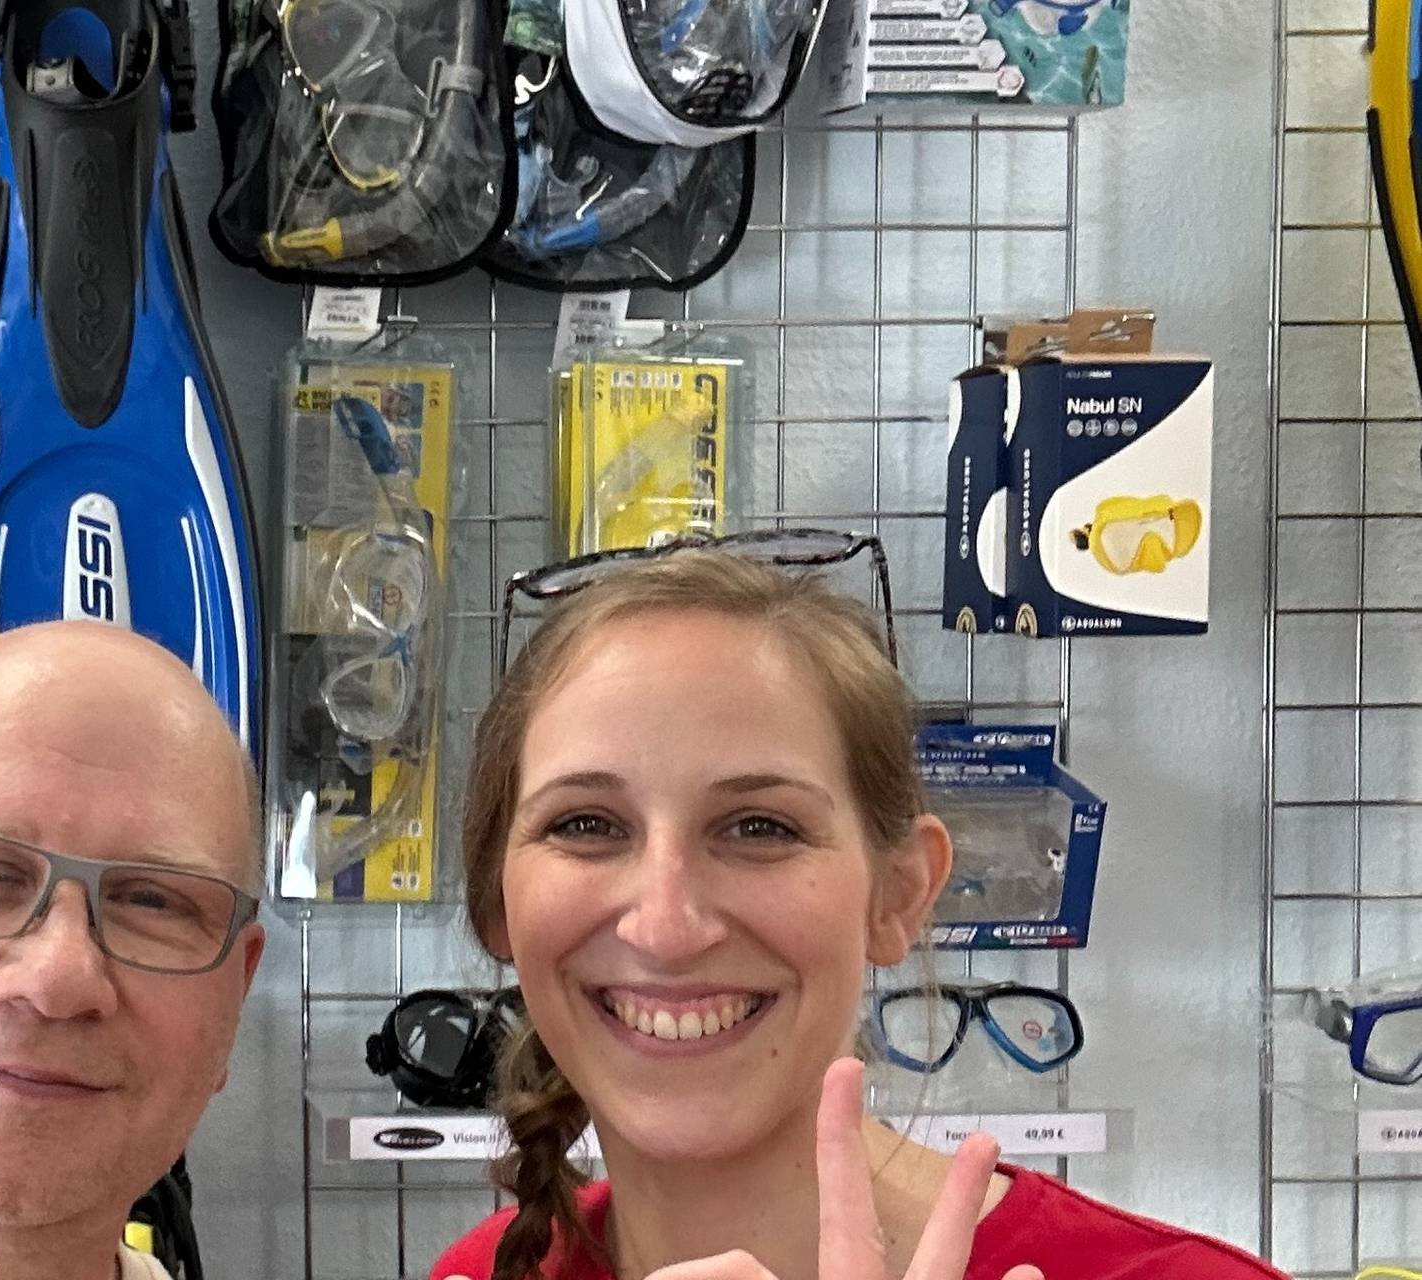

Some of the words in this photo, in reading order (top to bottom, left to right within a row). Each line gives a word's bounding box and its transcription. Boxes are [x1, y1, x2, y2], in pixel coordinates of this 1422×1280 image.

[1067, 397, 1114, 414] Nabul
[1118, 396, 1142, 413] SN
[78, 514, 114, 621] SSI
[932, 925, 978, 944] SSI
[453, 1132, 486, 1145] Vision
